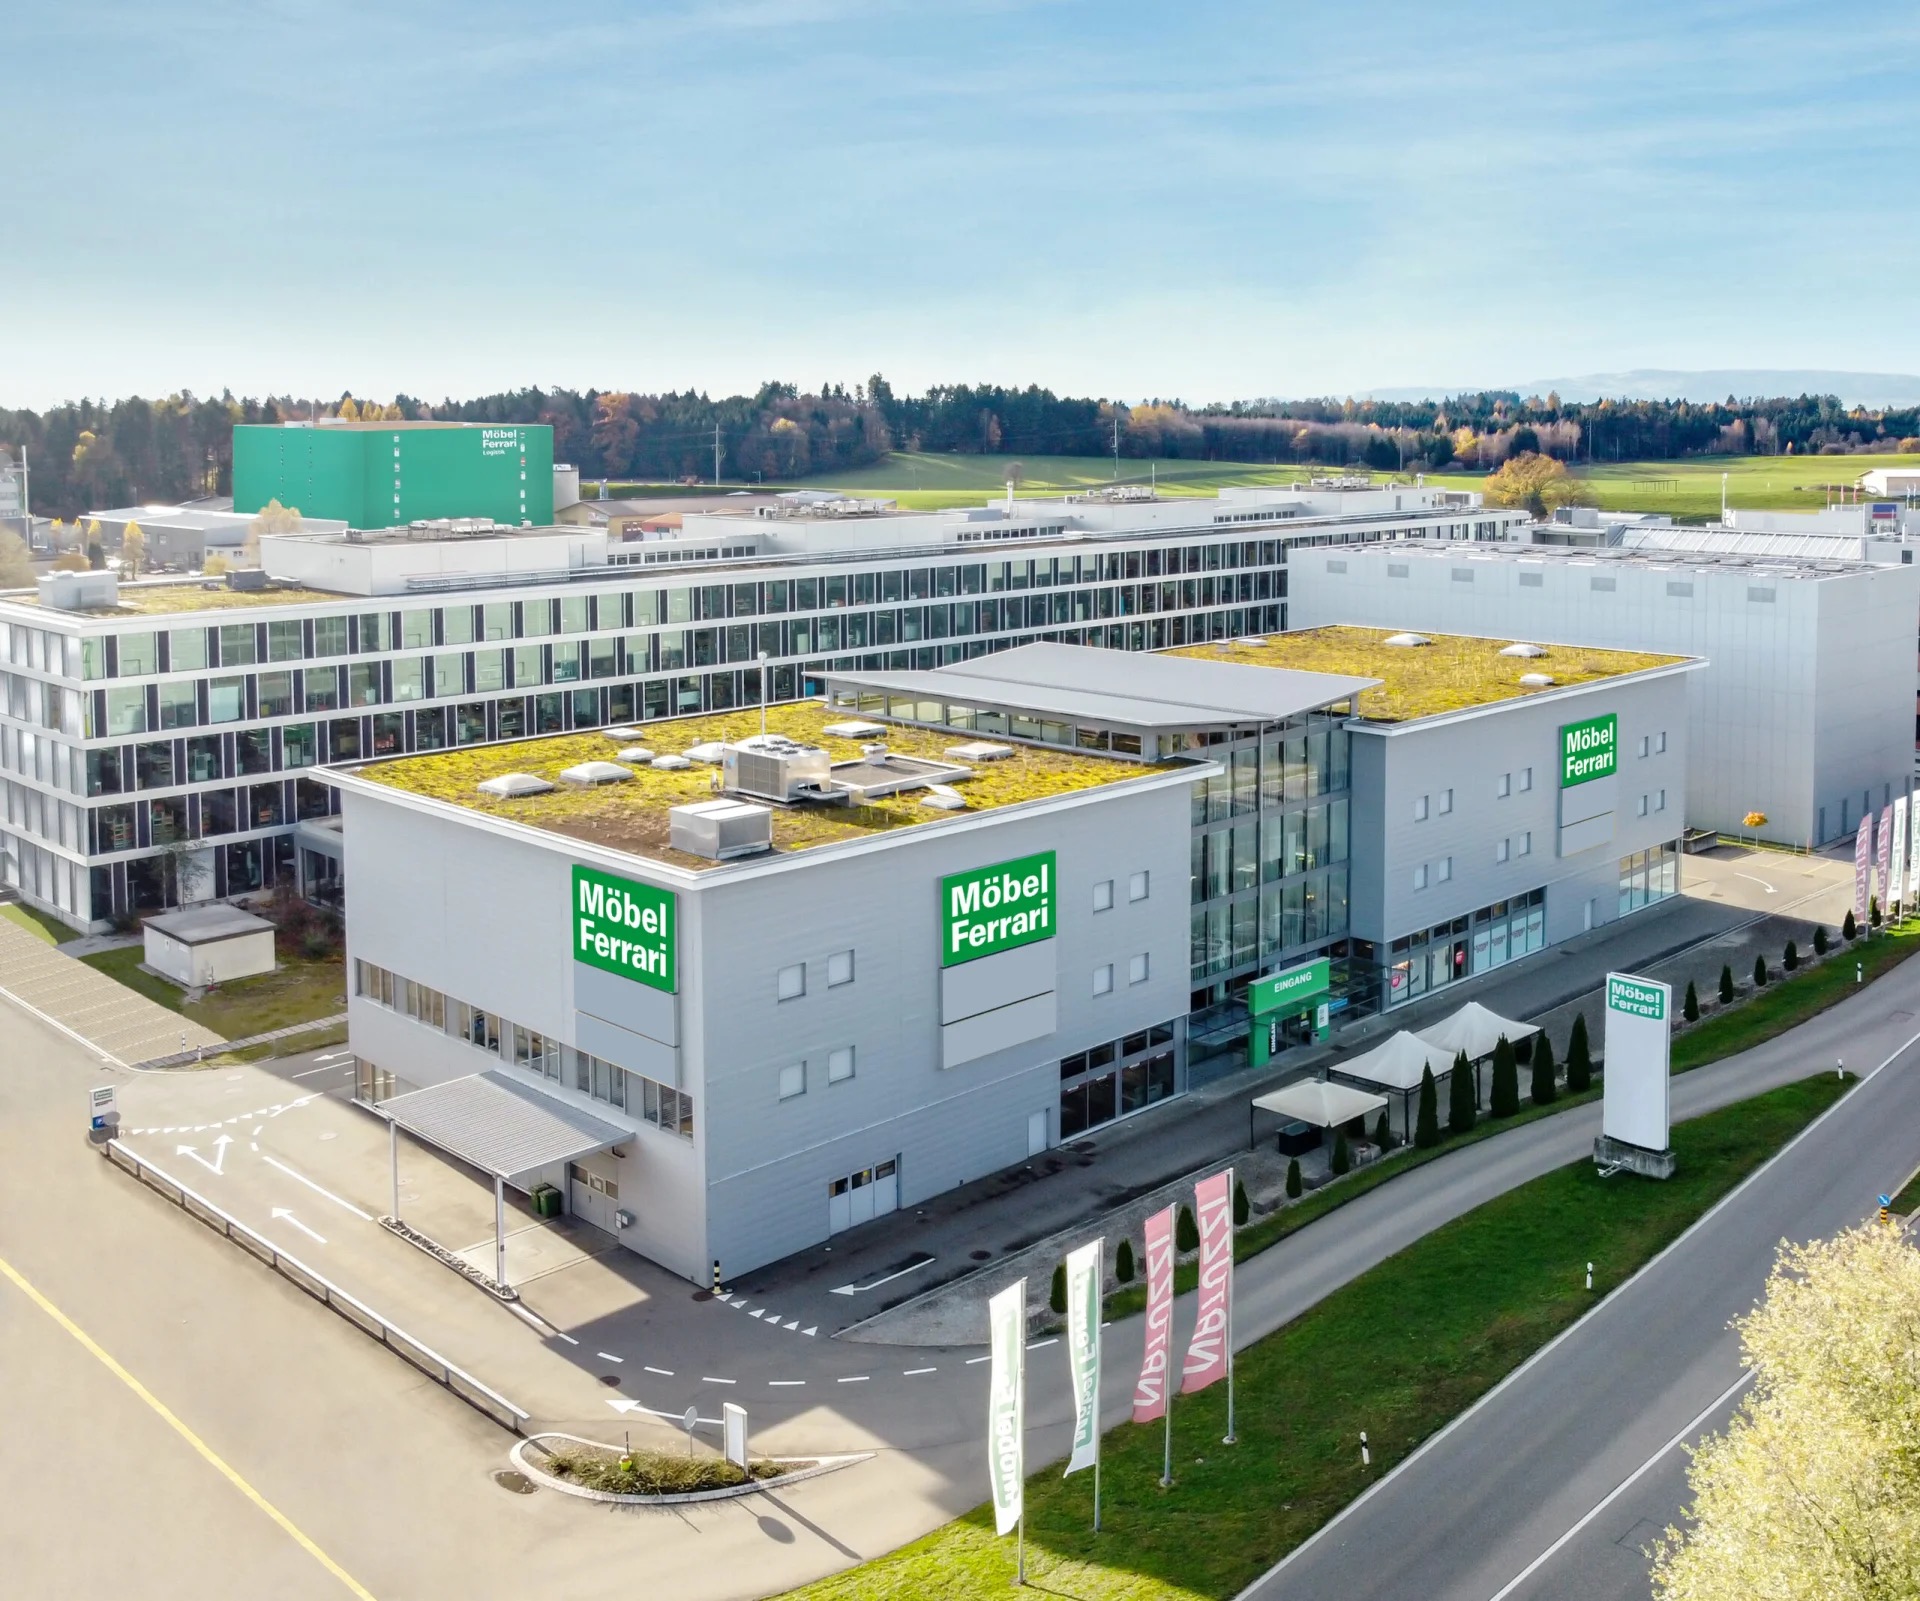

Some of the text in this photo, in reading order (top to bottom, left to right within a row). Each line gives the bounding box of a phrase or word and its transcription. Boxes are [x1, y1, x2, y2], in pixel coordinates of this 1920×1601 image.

[482, 430, 517, 439] Möbel
[482, 439, 517, 448] Ferrari
[1567, 722, 1613, 754] Möbel
[1566, 746, 1613, 778] Ferrari
[952, 864, 1048, 918] Möbel
[580, 879, 667, 938] Möbel
[952, 898, 1048, 953] Ferrari
[580, 917, 667, 977] Ferrari
[1275, 972, 1312, 993] EINGANG
[1611, 982, 1660, 1004] Möbel
[1611, 994, 1660, 1016] Ferrari
